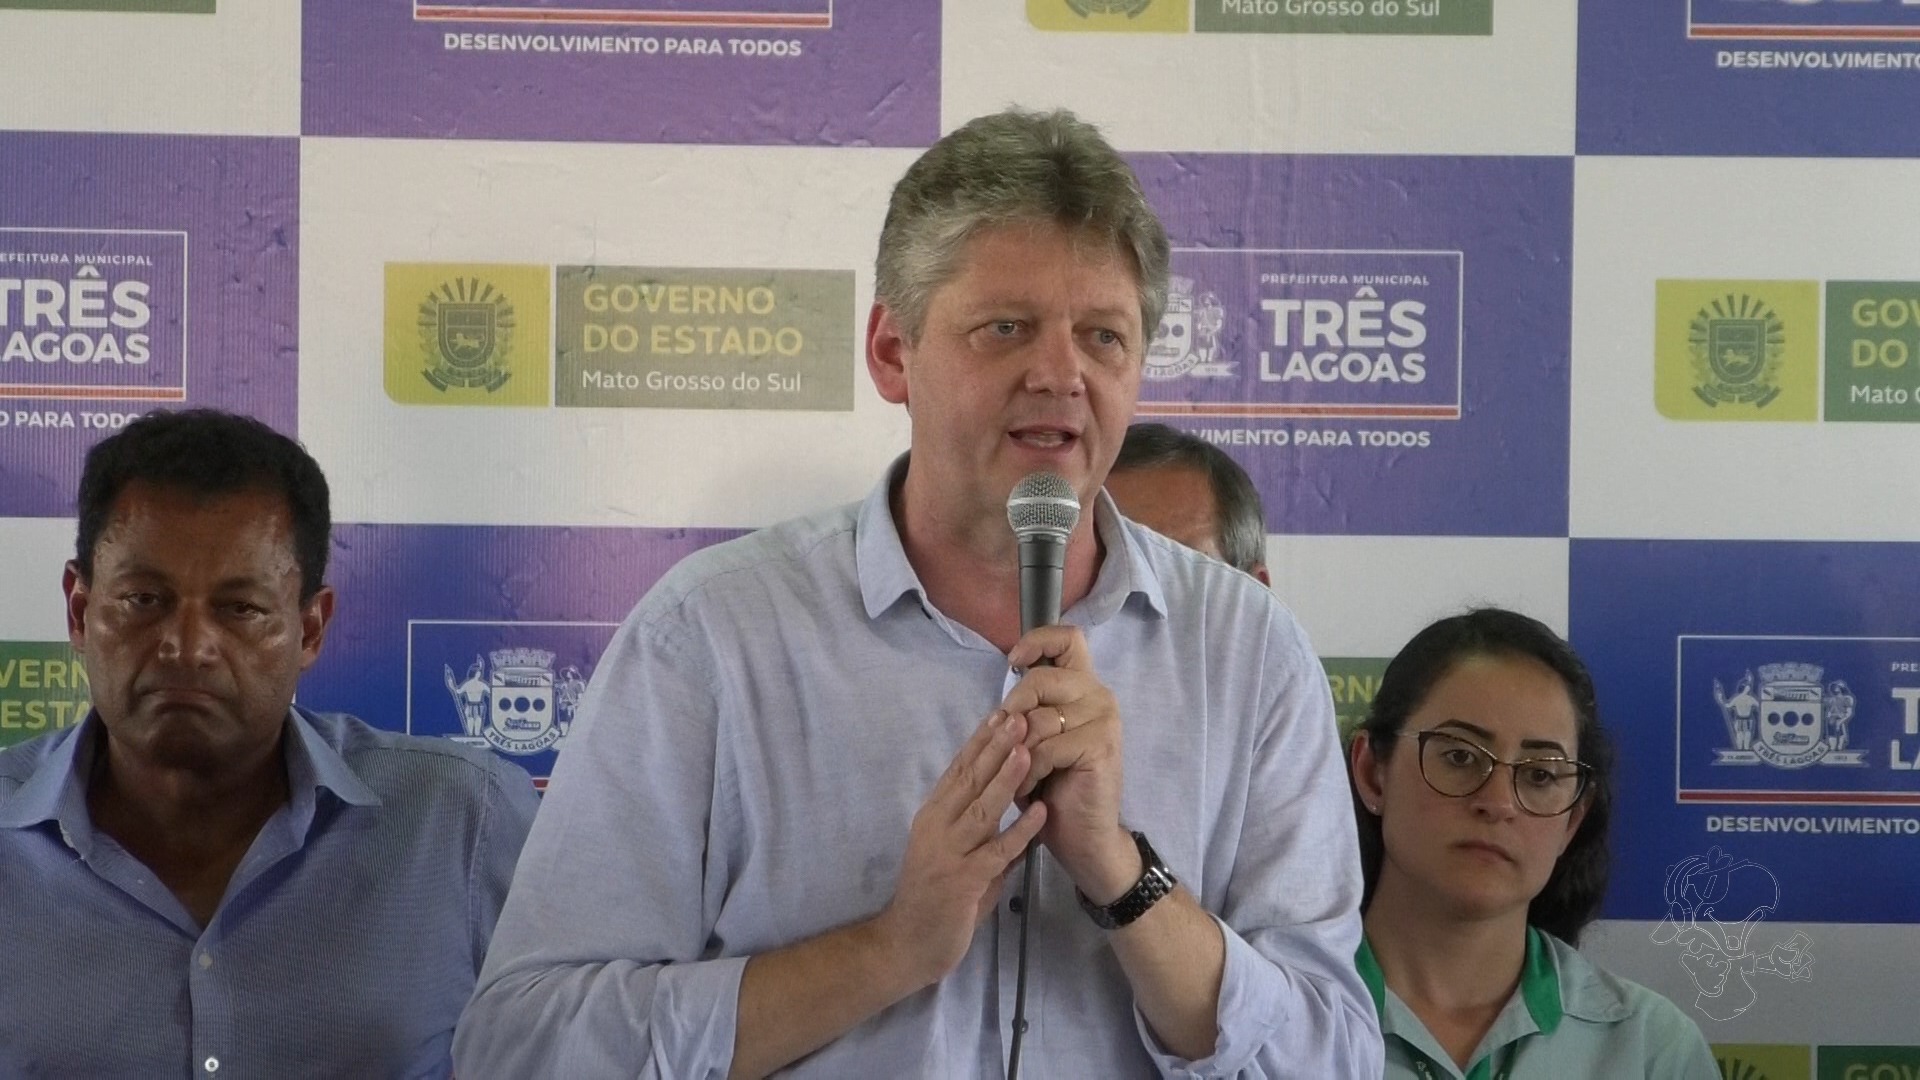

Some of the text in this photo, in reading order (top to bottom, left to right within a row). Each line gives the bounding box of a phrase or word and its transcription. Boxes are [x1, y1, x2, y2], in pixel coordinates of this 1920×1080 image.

[443, 33, 802, 56] DESENVOLVIMENTO PARA TODOS
[74, 254, 153, 266] MUNICIPAL
[1261, 273, 1430, 286] PREFEITURA MUNICIPAL
[583, 283, 775, 315] GOVERNO
[1261, 286, 1427, 348] TRÊS
[583, 323, 803, 355] DO ESTADO
[1853, 339, 1909, 368] DO
[1260, 351, 1427, 383] LAGOAS
[582, 370, 801, 392] Mato Grosso do Sul
[1850, 385, 1908, 404] Mato
[15, 411, 75, 428] PARA
[1294, 430, 1352, 446] PARA
[1358, 430, 1431, 447] TODOS
[1706, 815, 1920, 834] DESENVOLVIMENTO
